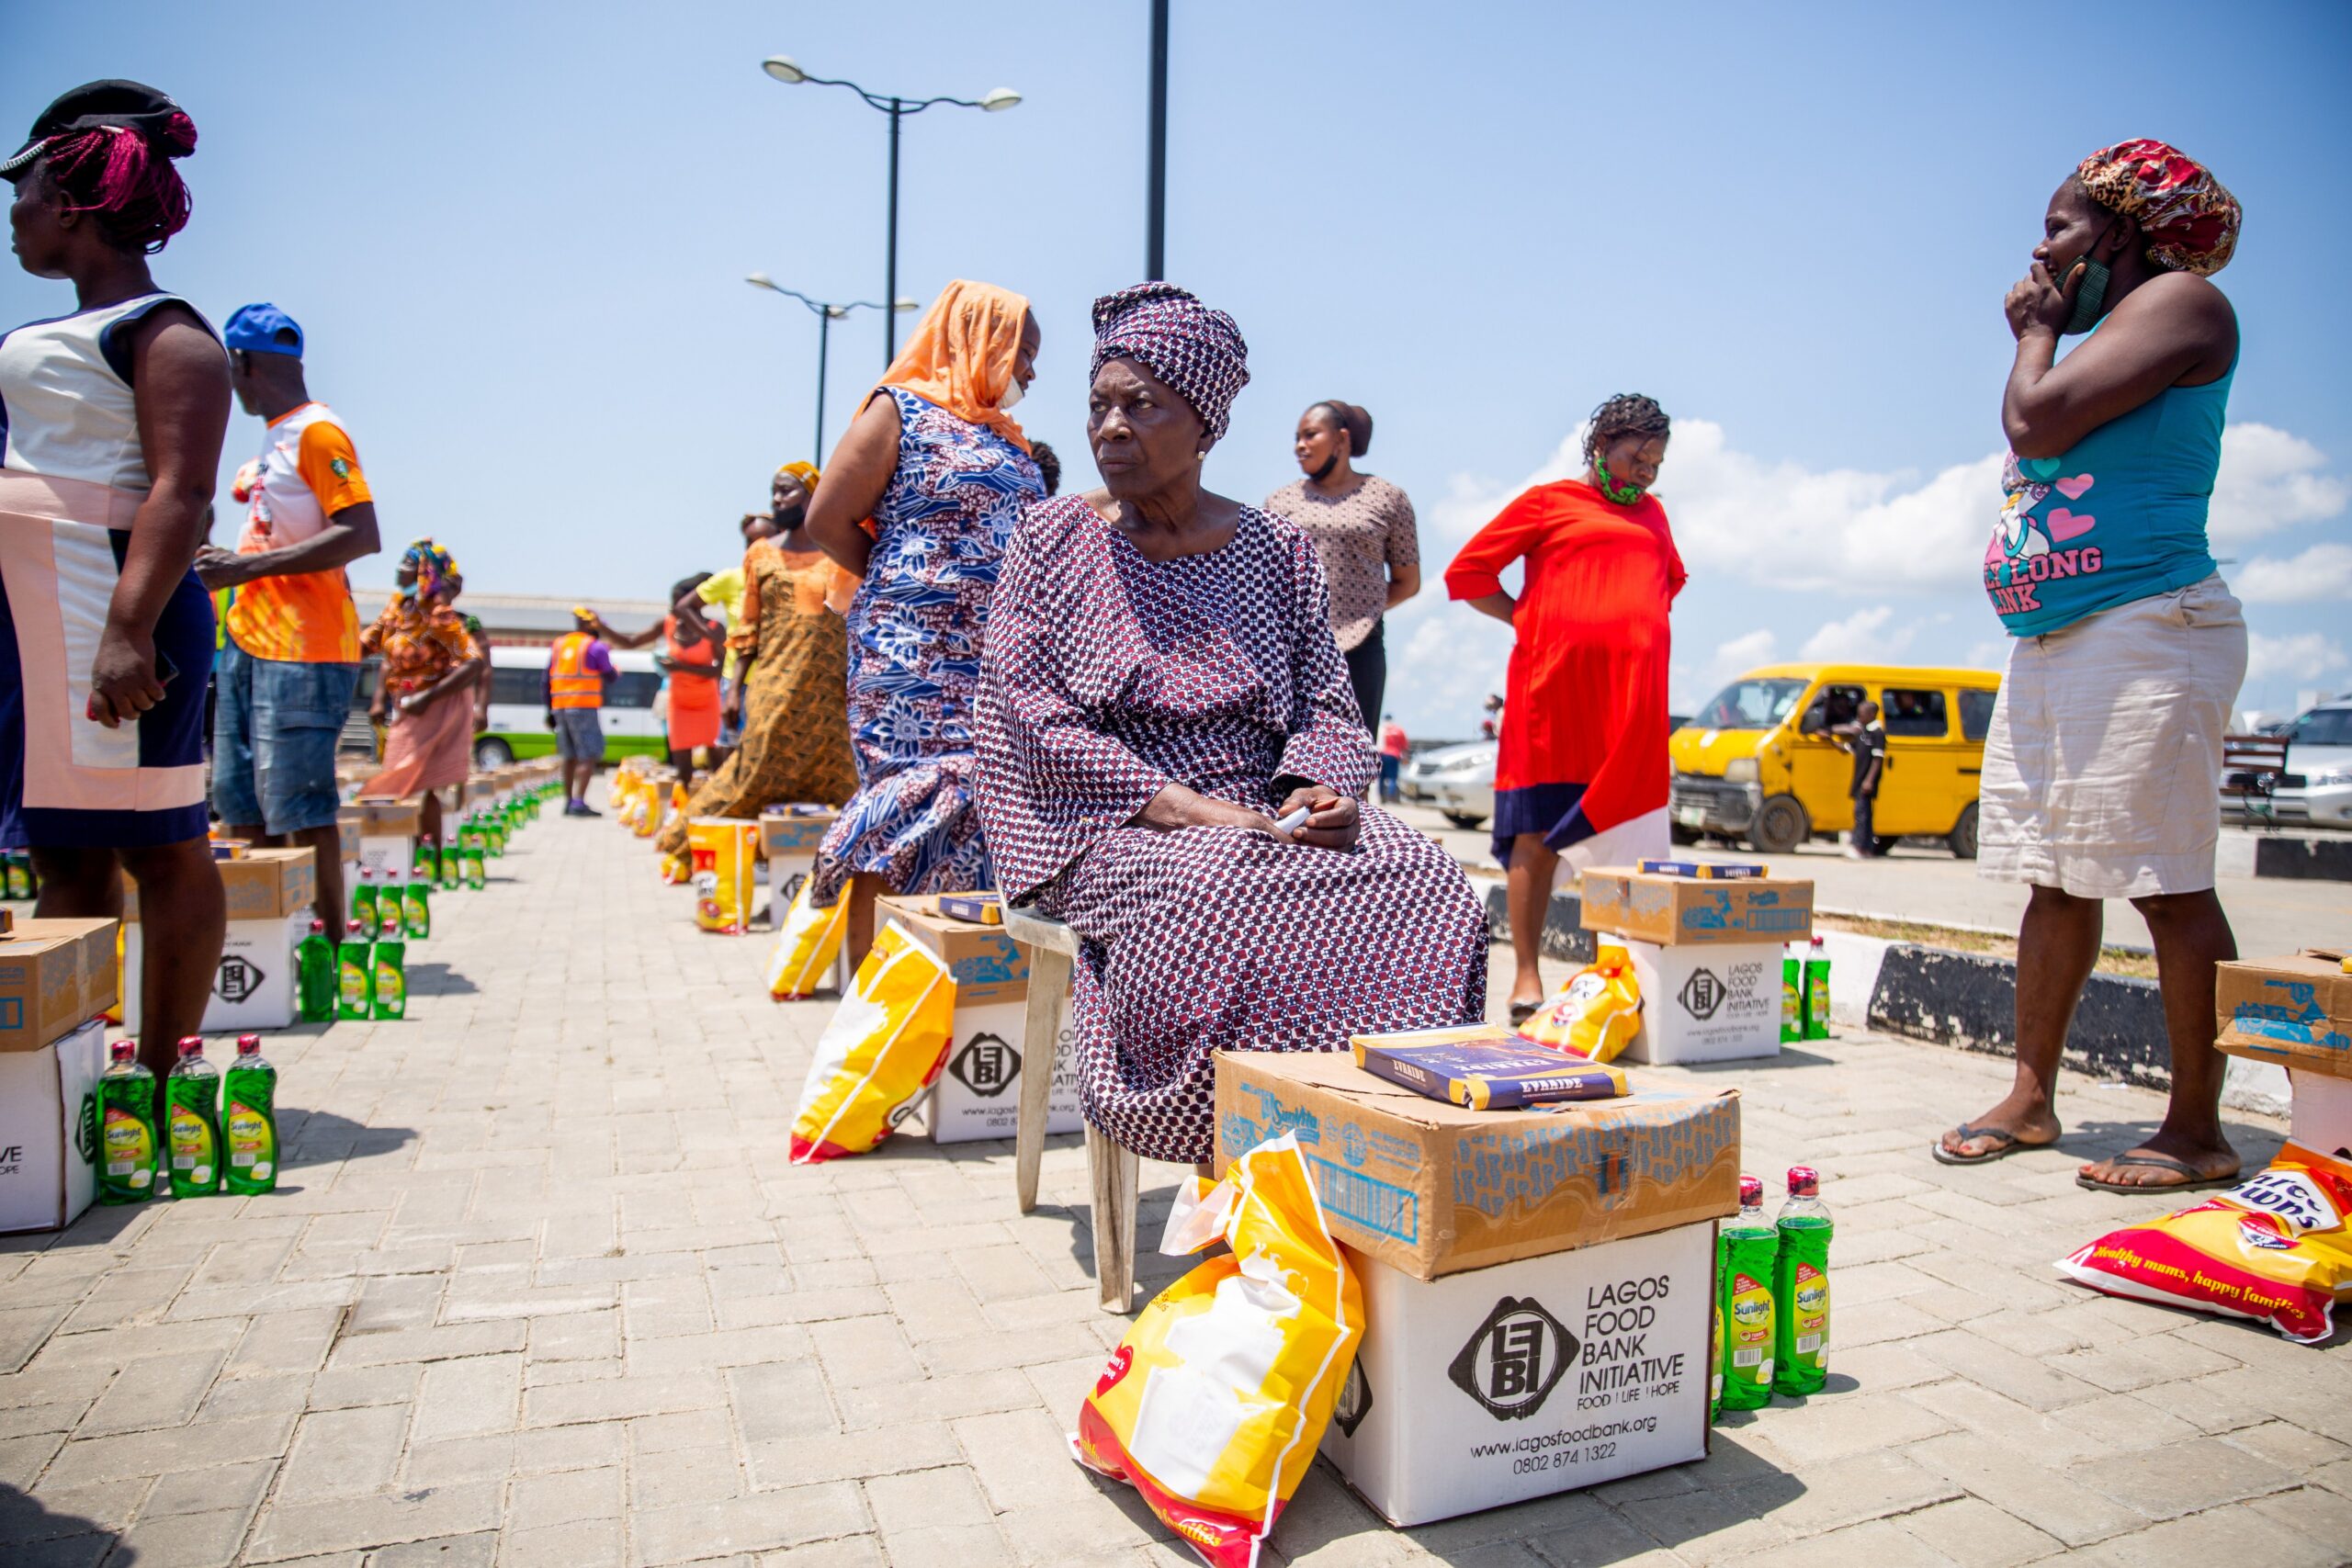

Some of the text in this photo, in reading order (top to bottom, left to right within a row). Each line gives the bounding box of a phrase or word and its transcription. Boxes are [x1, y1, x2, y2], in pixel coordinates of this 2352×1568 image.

[2008, 547, 2102, 586] LONG
[1728, 963, 1762, 976] LAGOS
[1727, 976, 1757, 987] FOOD
[1727, 988, 1753, 999] BANK
[1727, 998, 1770, 1011] INITIATIVE
[106, 1127, 141, 1139] Sunlight
[172, 1123, 202, 1134] Sunlight
[231, 1122, 262, 1133] Sunlight
[2093, 1246, 2306, 1320] Healthy mums, happy families
[1588, 1275, 1669, 1310] LAGOS
[1796, 1288, 1826, 1304] Sunlight
[1734, 1299, 1770, 1315] Sunlight
[1585, 1305, 1655, 1338] FOOD
[1582, 1334, 1646, 1367] BANK
[1580, 1353, 1684, 1394] INITIATIVE
[1577, 1381, 1679, 1411] FOOD LIFE HOPE
[1513, 1441, 1616, 1475] 0802 874 1322
